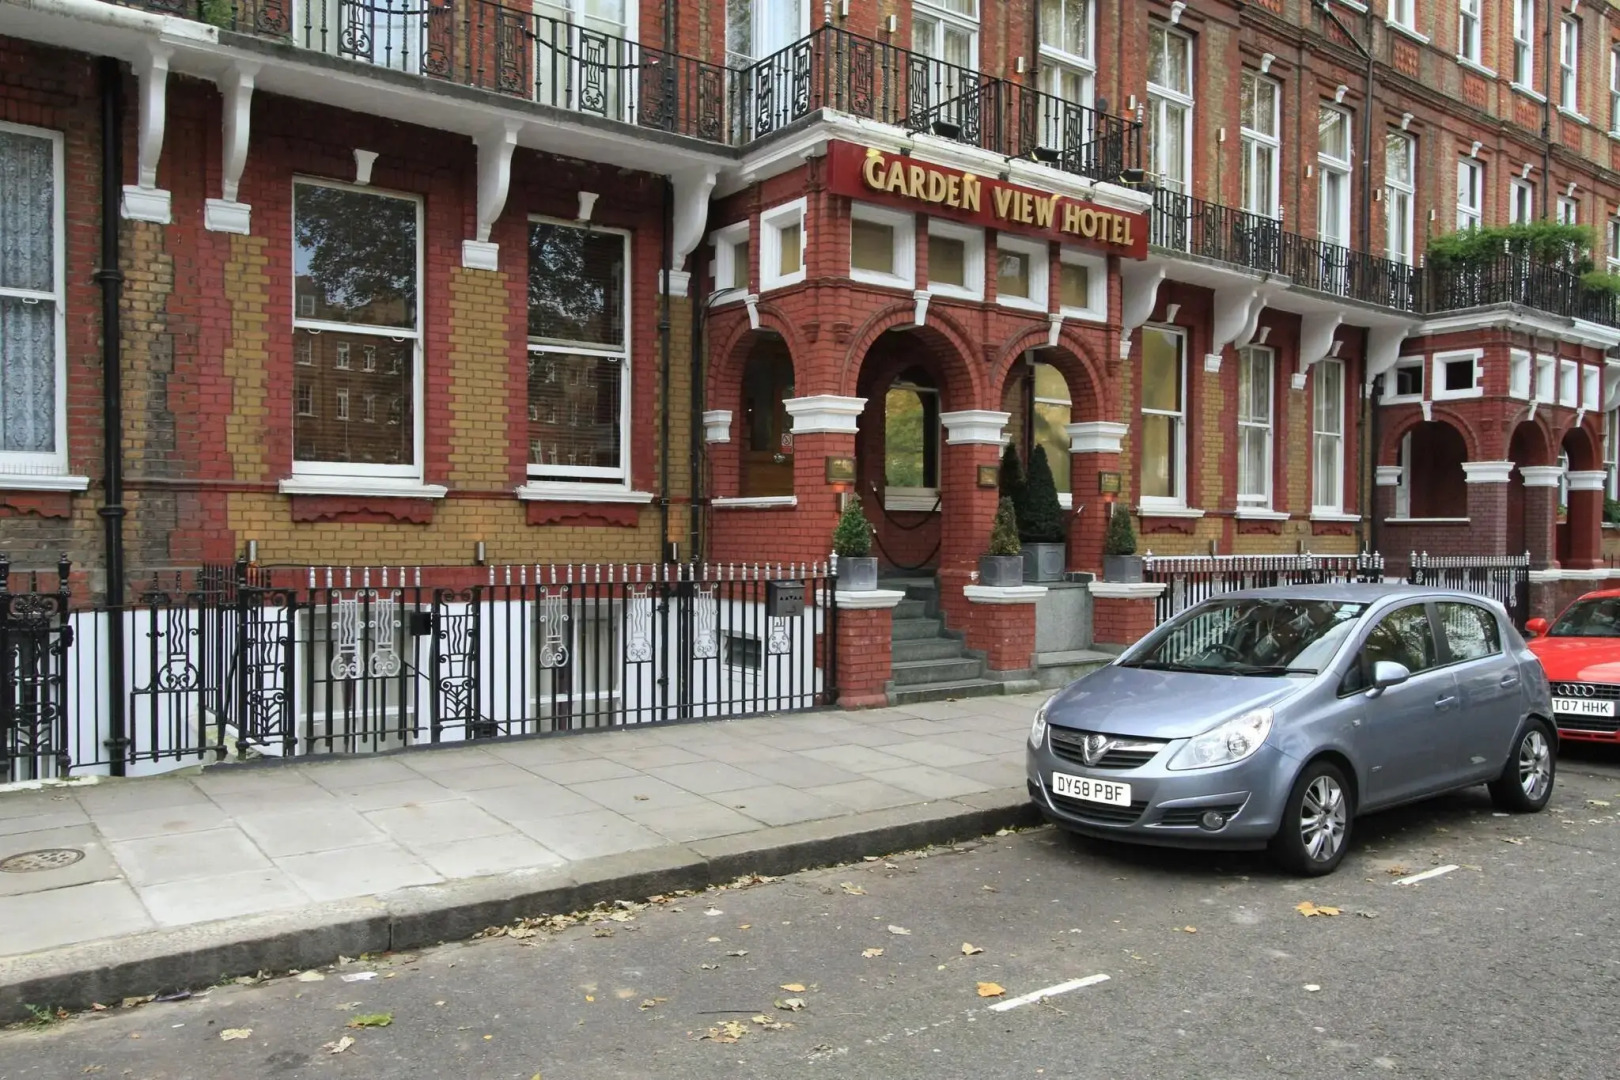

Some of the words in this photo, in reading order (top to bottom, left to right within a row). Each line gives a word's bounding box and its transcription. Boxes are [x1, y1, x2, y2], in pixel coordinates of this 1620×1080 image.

[863, 154, 981, 213] GARDEN
[993, 185, 1058, 229] VIEW
[1061, 203, 1134, 247] HOTEL
[1582, 701, 1608, 713] HHK
[1058, 776, 1090, 797] DY58
[1094, 783, 1124, 802] PBF
